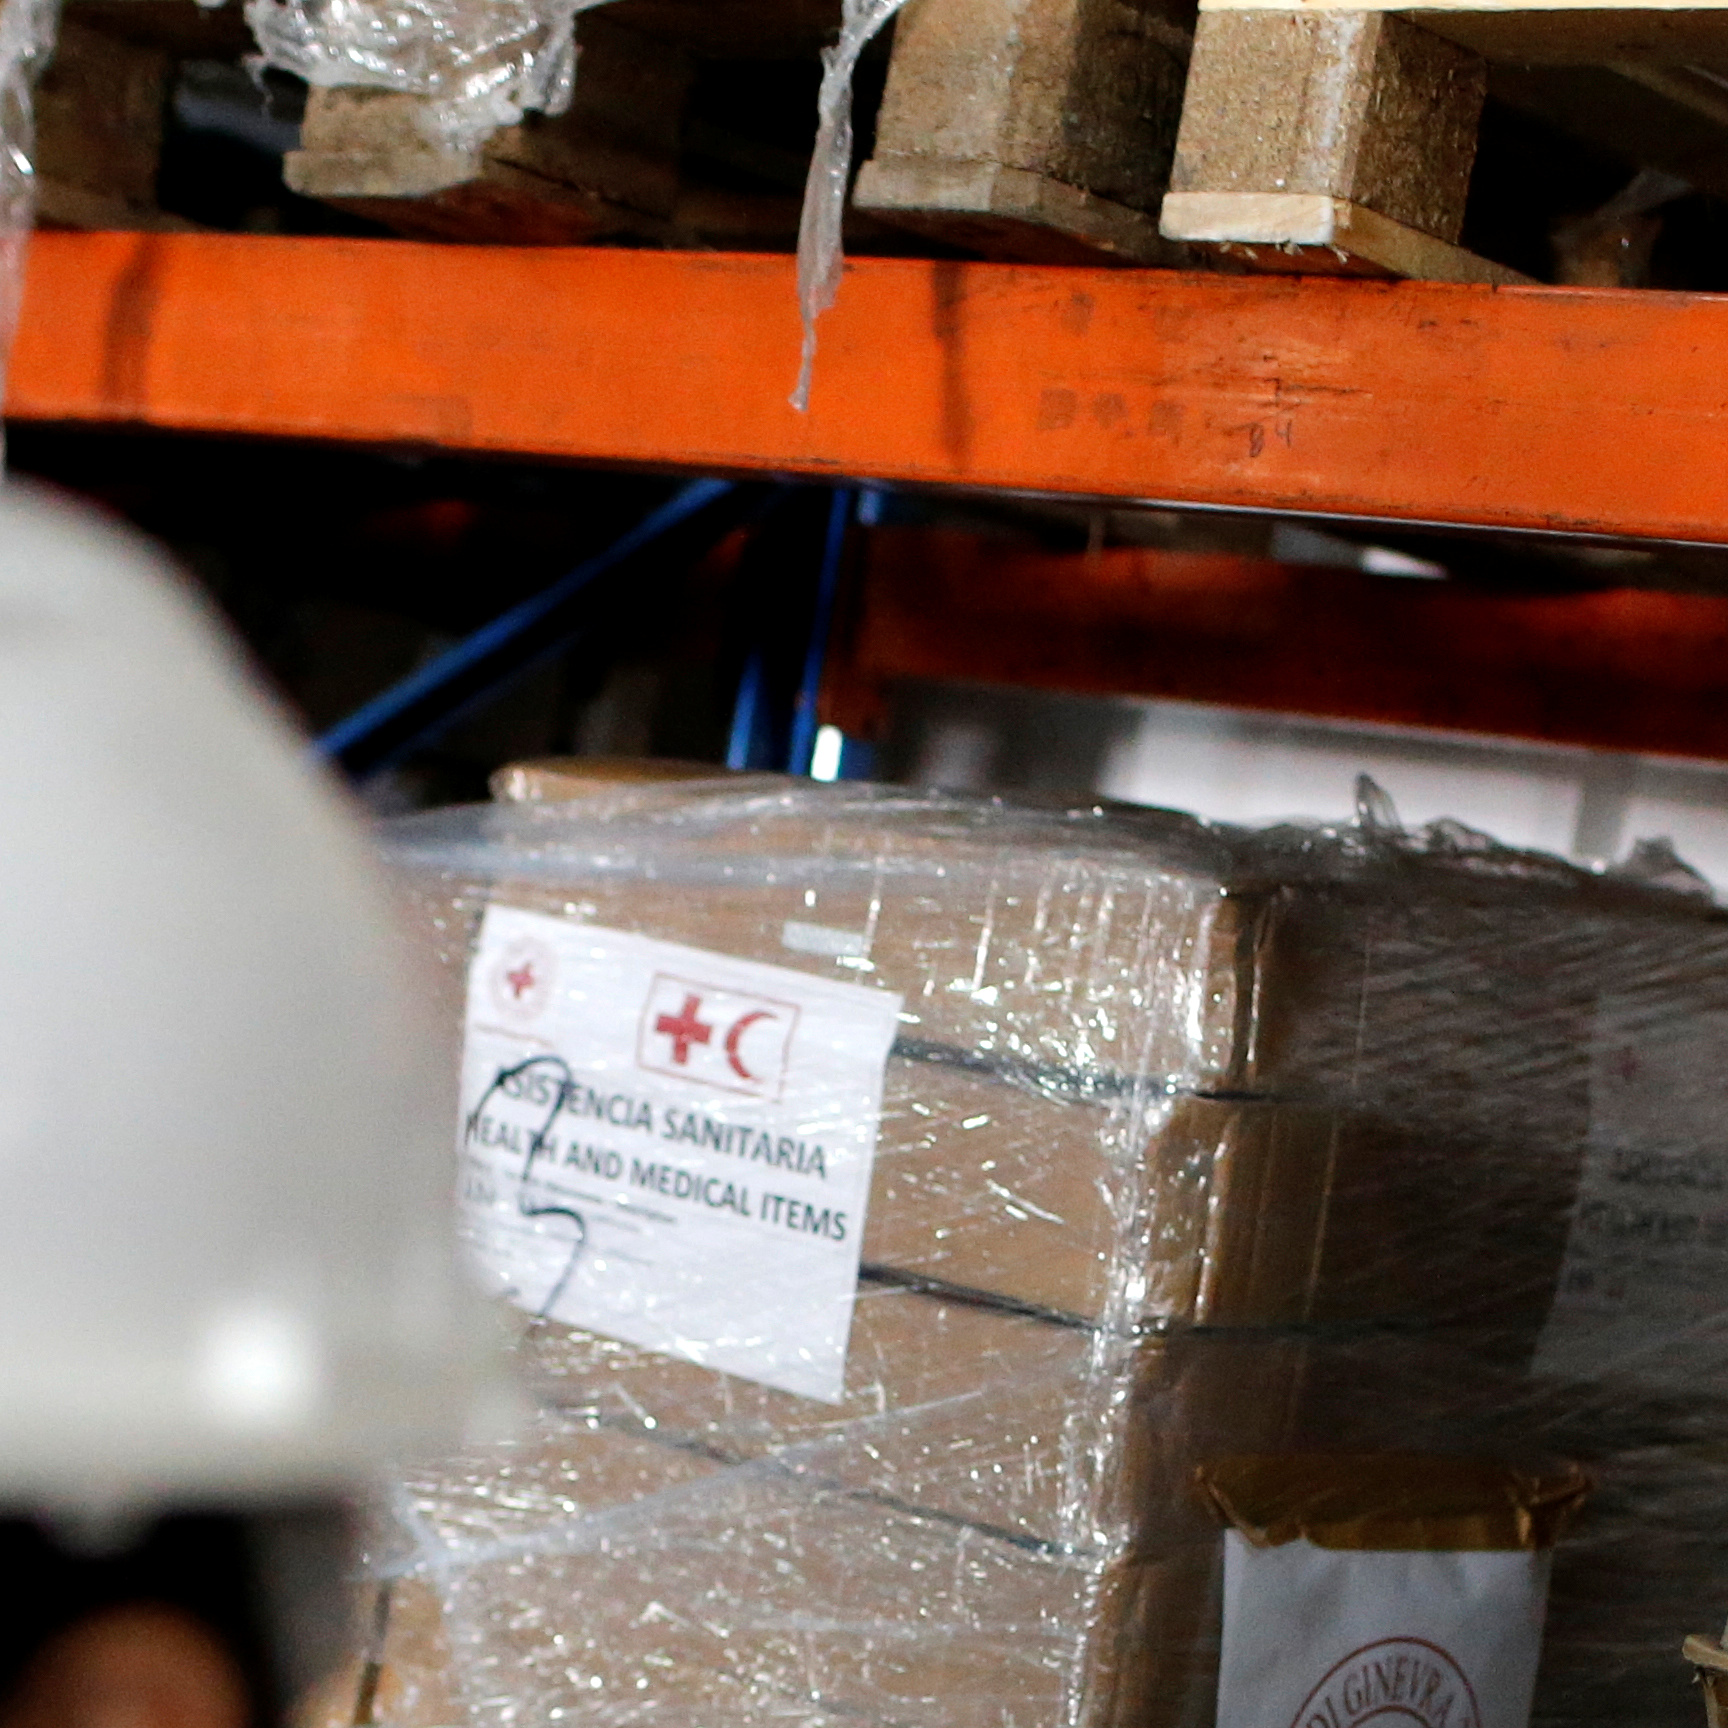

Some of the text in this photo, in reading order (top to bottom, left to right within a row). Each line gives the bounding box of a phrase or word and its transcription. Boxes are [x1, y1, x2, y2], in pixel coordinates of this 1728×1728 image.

[661, 1108, 828, 1179] SANITARIA
[563, 1140, 624, 1181] AND
[629, 1159, 752, 1218] MEDICAL
[760, 1192, 847, 1242] ITEMS
